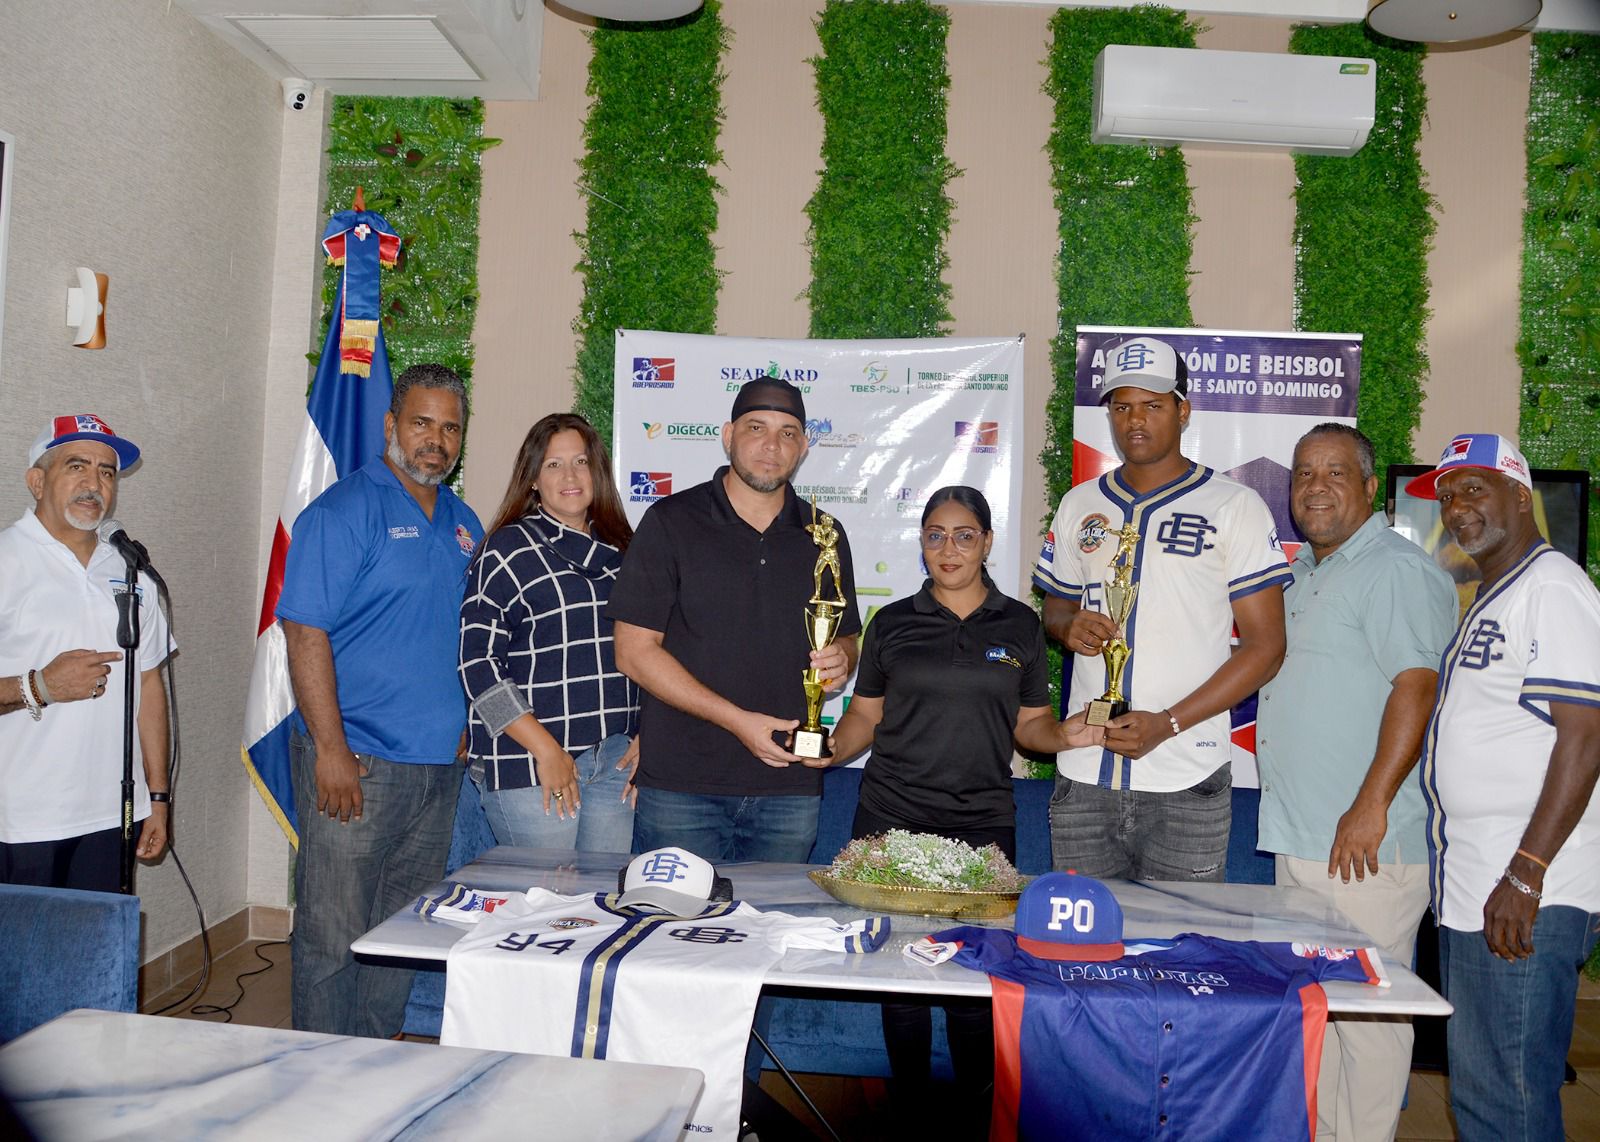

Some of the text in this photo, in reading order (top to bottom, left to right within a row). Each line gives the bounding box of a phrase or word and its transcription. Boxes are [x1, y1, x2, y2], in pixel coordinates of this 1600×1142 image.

[1225, 353, 1251, 374] DE
[1259, 354, 1345, 378] BEISBOL
[917, 372, 942, 381] TORNEO
[978, 373, 1009, 382] SUPERIOR
[1206, 378, 1257, 396] SANTO
[1262, 381, 1343, 399] DOMINGO
[667, 425, 720, 436] DIGECAC
[1047, 896, 1095, 933] PO
[1187, 985, 1214, 996] 14
